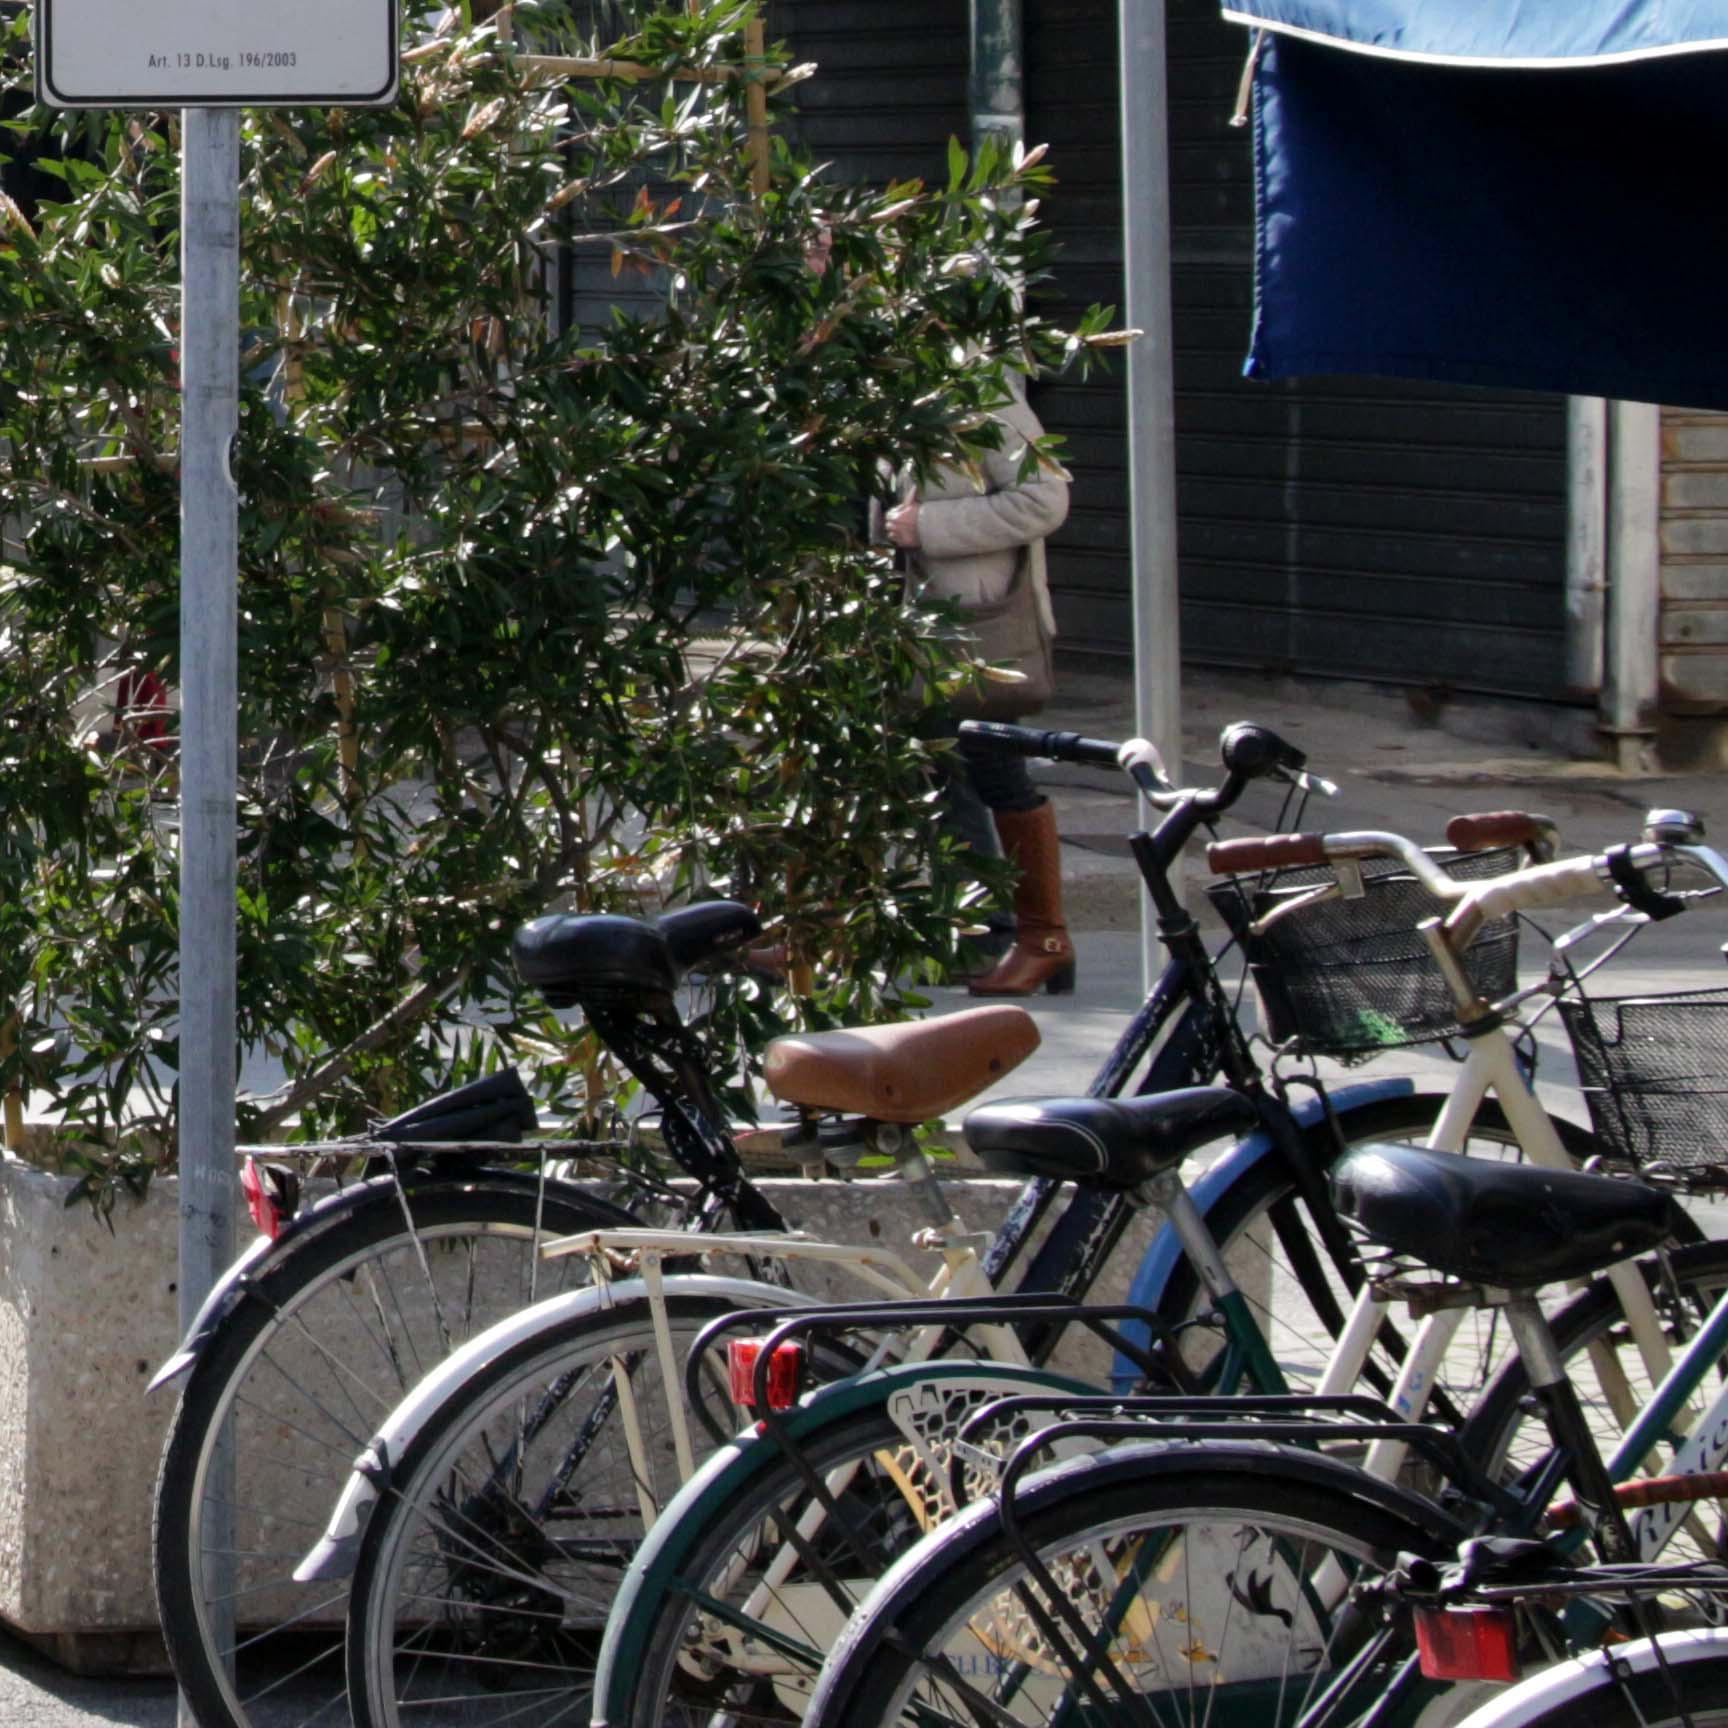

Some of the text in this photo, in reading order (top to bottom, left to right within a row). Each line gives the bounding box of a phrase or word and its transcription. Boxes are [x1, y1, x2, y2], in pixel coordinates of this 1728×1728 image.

[148, 53, 170, 68] Art.
[177, 53, 191, 68] 13
[239, 52, 297, 68] 196/2003
